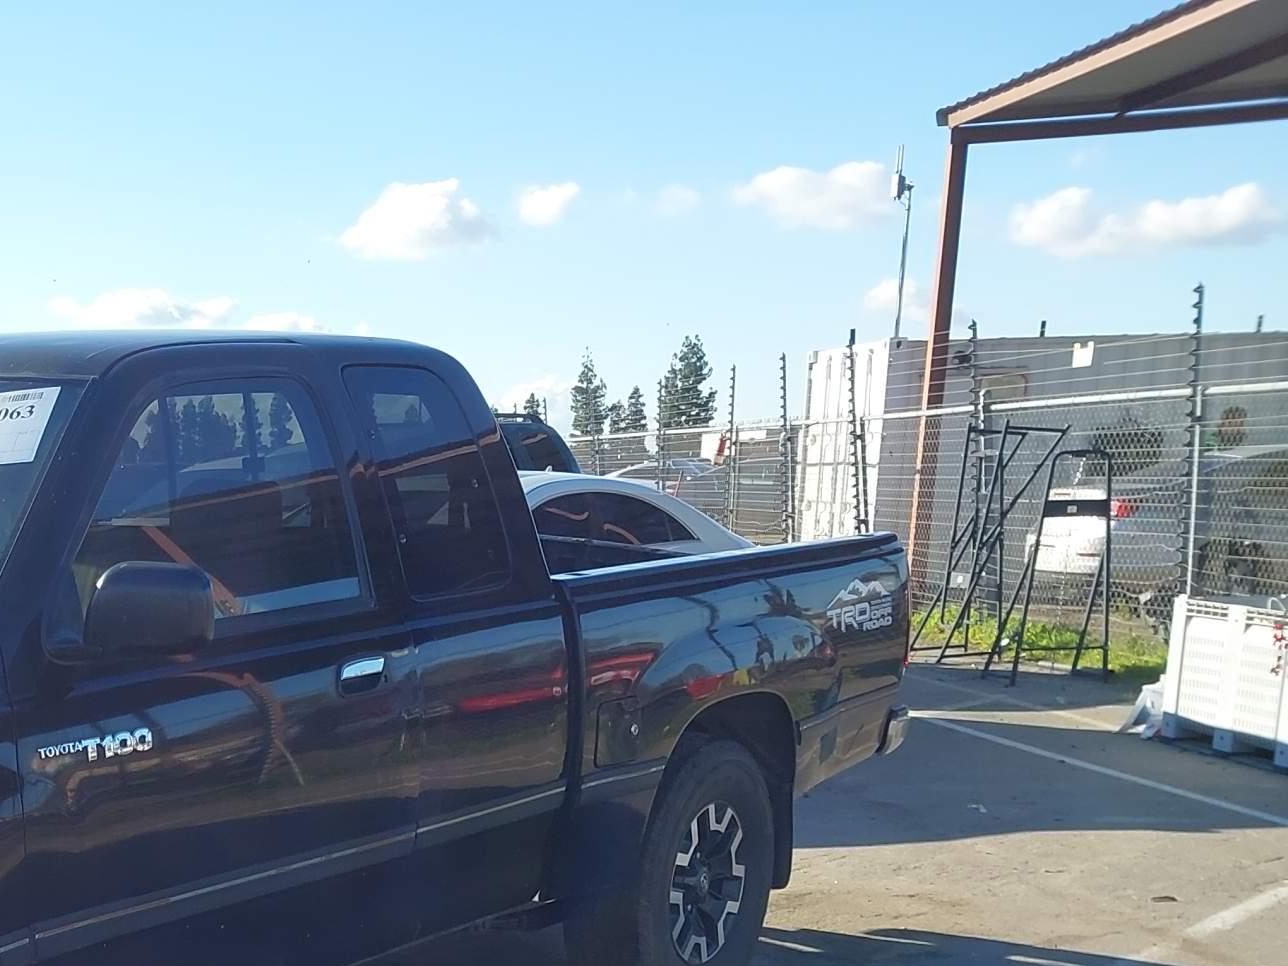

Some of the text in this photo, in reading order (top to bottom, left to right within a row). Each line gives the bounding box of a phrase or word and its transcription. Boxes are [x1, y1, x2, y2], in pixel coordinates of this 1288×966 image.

[826, 602, 892, 632] TRD OFF
[863, 616, 892, 632] ROAD
[38, 728, 152, 762] TOYOTA T100
